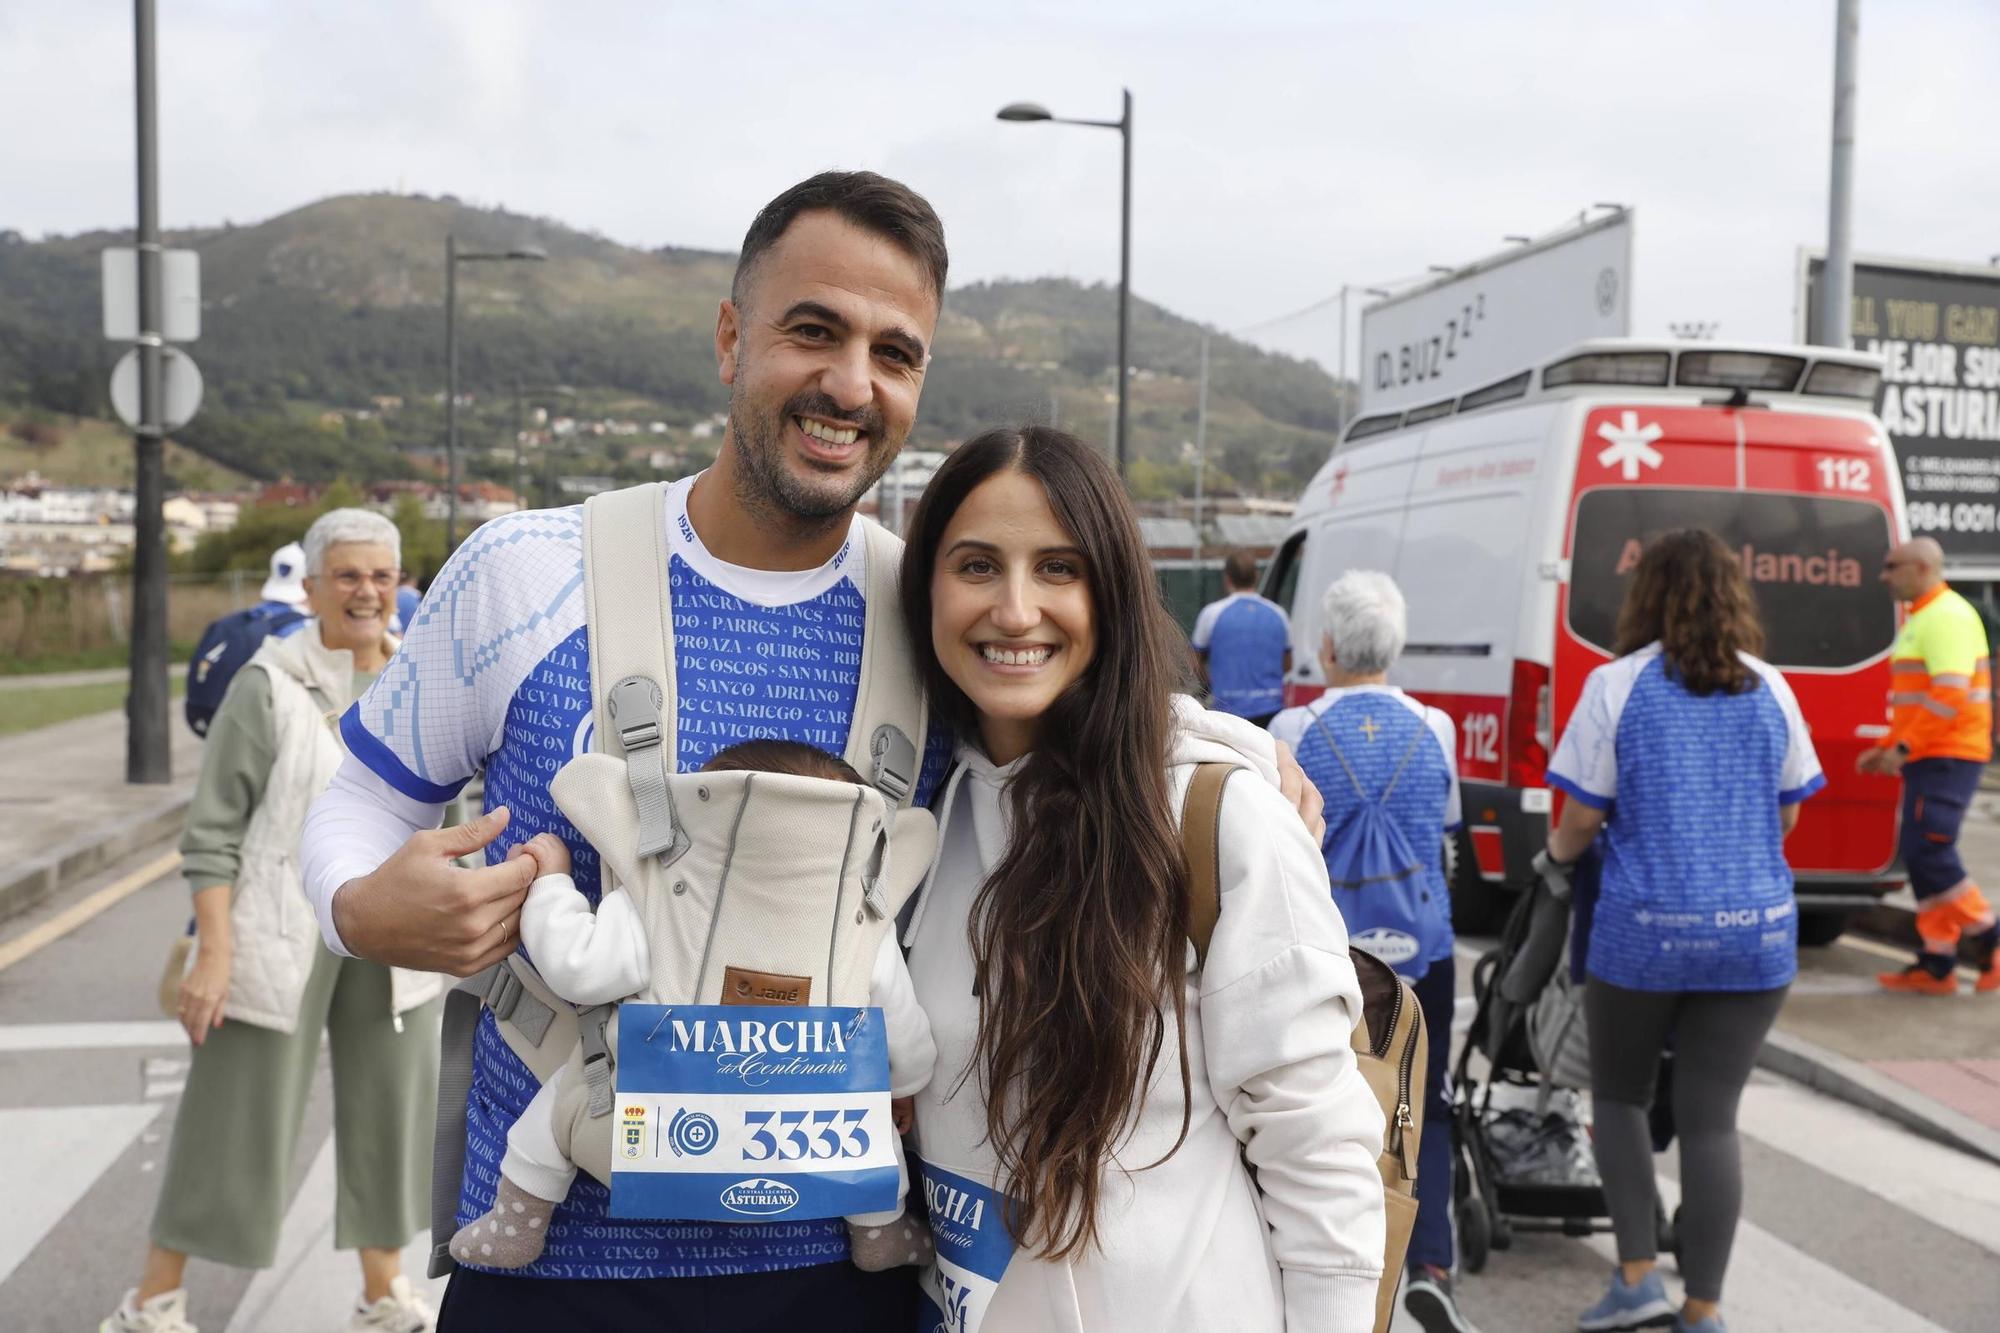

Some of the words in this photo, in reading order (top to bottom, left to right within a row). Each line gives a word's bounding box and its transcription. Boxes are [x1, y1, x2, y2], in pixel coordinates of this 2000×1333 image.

[1886, 300, 1937, 339] YOU
[1817, 457, 1871, 492] 112
[677, 513, 695, 543] 1926
[1615, 538, 1861, 587] Alancia
[674, 635, 742, 653] PROAZA
[756, 642, 820, 661] QUIRÓS
[542, 670, 590, 692] BARC
[710, 659, 768, 677] OSCOS
[778, 664, 810, 680] SAN
[762, 684, 840, 703] ADRIANO
[1462, 713, 1499, 762] 112
[1715, 909, 1759, 928] DIGI
[756, 988, 798, 1002] jané
[670, 1020, 847, 1053] MARCHA
[735, 1051, 848, 1087] Centenario
[742, 1109, 871, 1160] 3333
[725, 1190, 794, 1205] ASTURIANA
